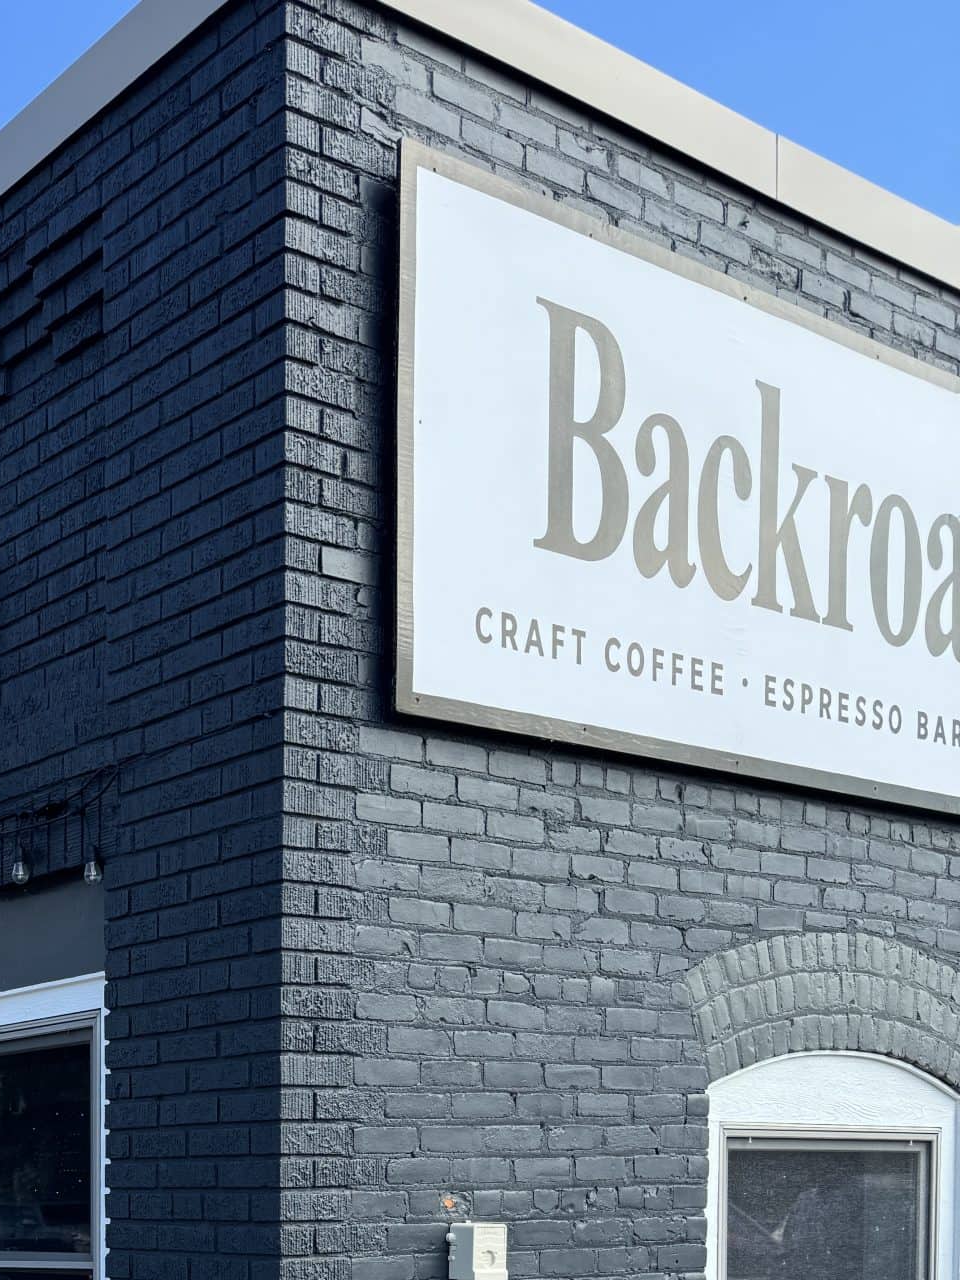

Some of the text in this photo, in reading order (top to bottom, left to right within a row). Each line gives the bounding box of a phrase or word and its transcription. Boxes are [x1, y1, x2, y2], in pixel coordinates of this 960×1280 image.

[475, 606, 587, 666] CRAFT
[604, 637, 724, 696] COFFEE
[764, 674, 903, 735] ESPRESSO
